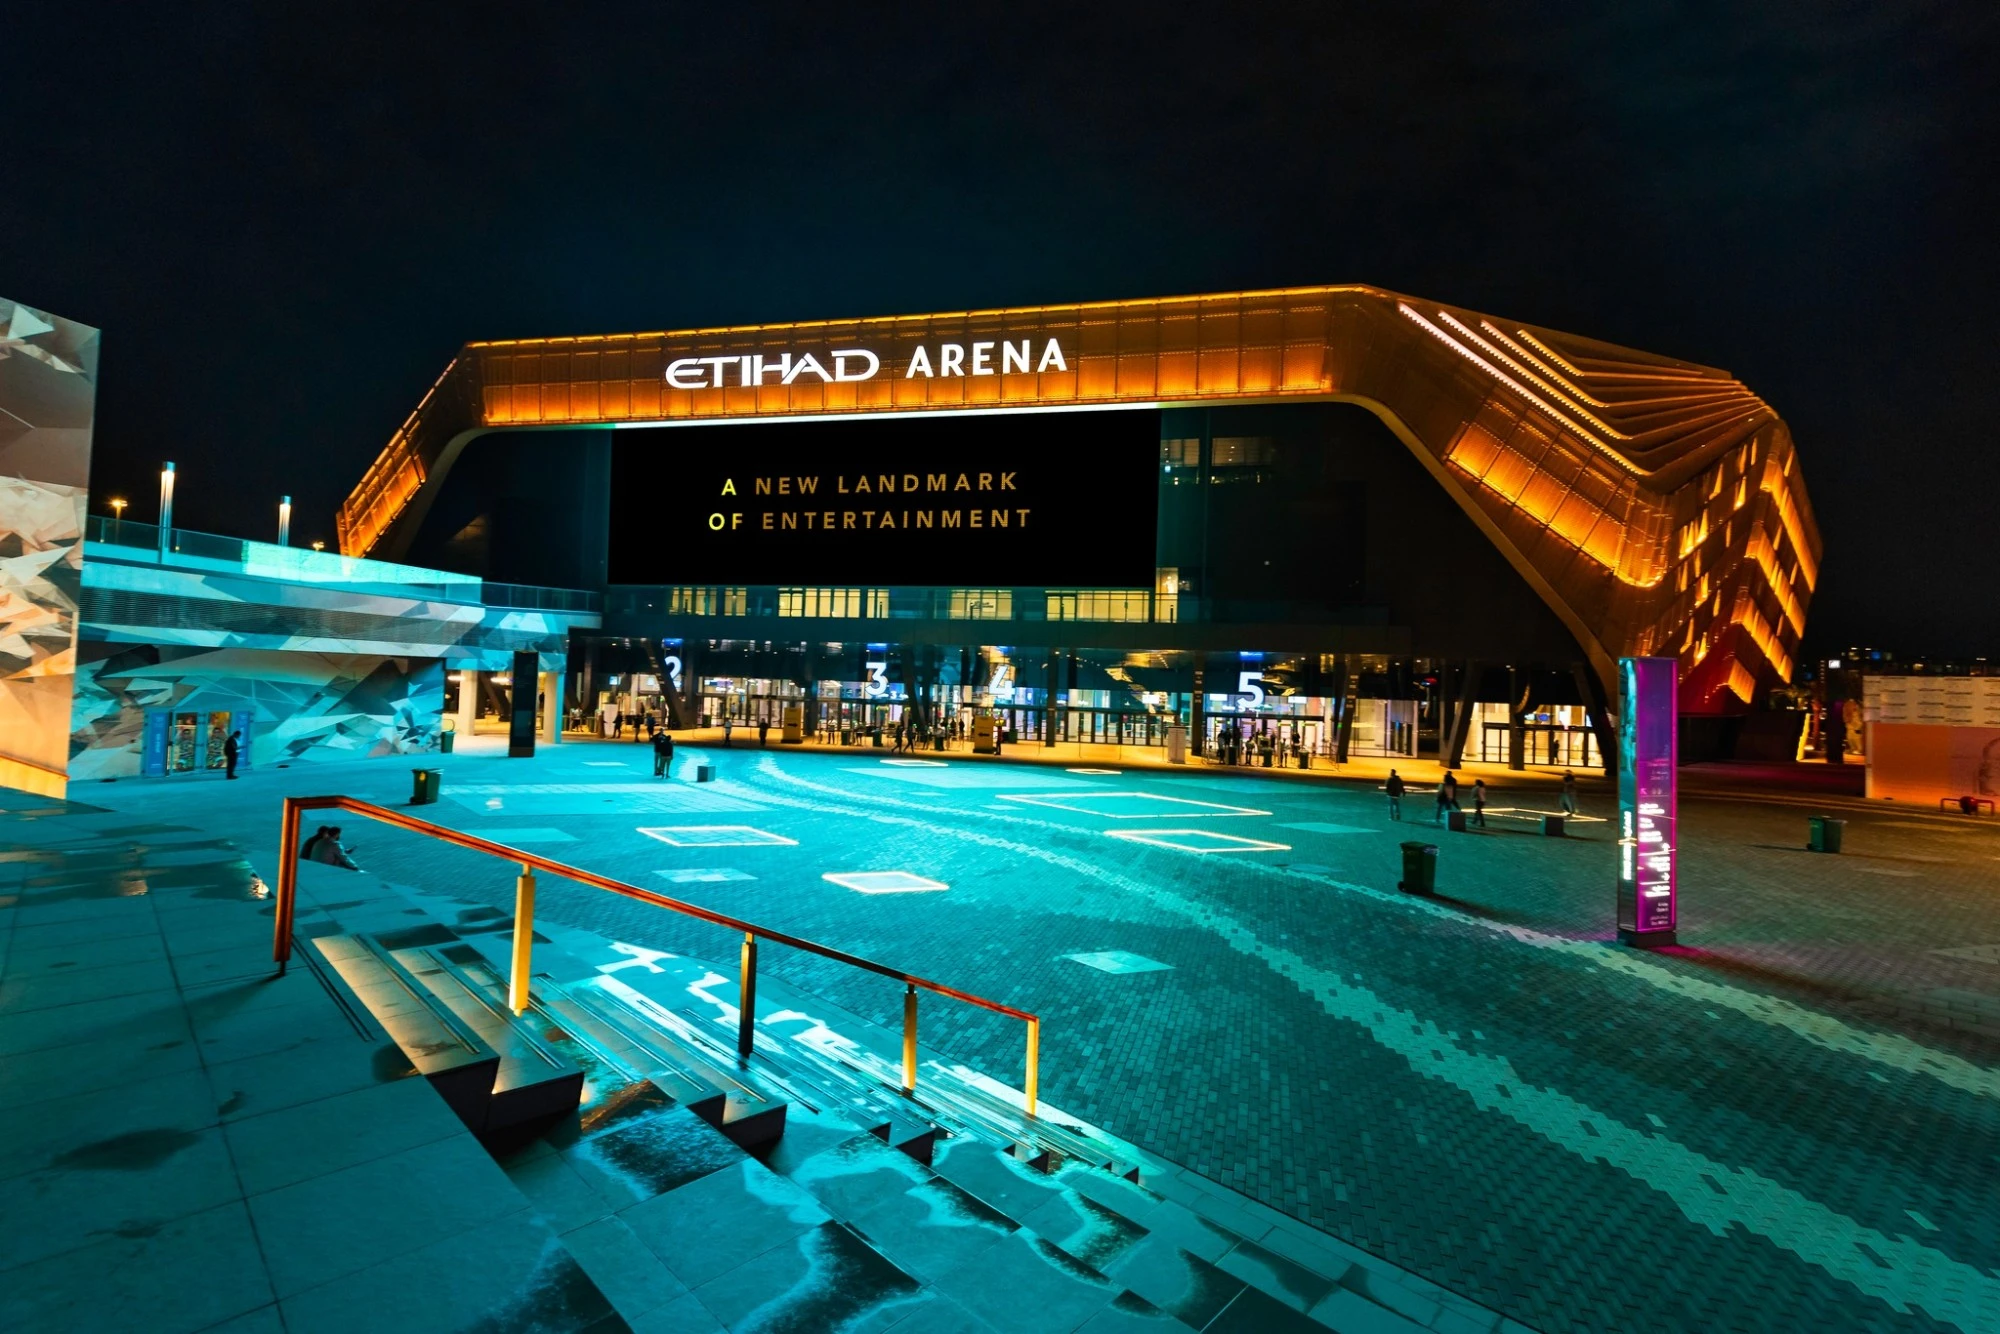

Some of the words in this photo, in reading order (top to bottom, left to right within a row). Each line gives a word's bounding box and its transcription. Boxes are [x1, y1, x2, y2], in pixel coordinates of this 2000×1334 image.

[665, 349, 880, 389] ETIHAD
[905, 337, 1068, 379] ARENA
[721, 477, 737, 496] A
[755, 476, 819, 495] NEW
[838, 471, 1018, 494] LANDMARK
[708, 512, 744, 531] OF
[762, 508, 1031, 530] ENTERTAINMENT
[865, 662, 888, 695] 3
[988, 664, 1015, 700] 4
[1237, 671, 1264, 708] 5
